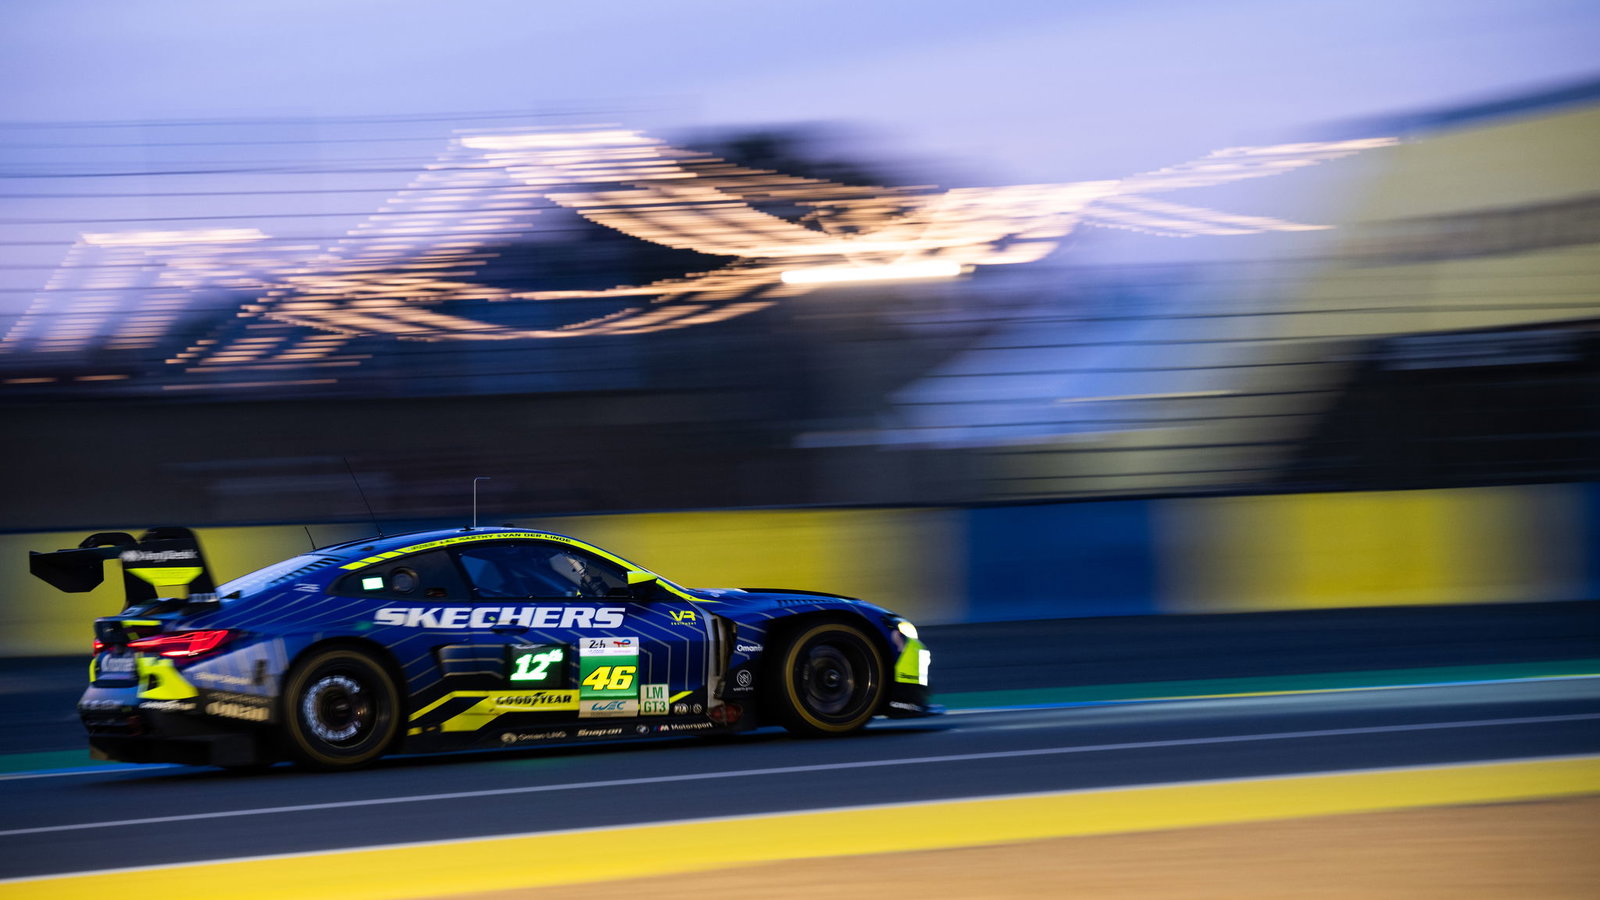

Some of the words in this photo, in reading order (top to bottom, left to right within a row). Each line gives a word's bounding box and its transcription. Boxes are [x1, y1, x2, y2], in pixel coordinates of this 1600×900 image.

[544, 534, 572, 543] LINDE
[373, 607, 626, 629] SKECHERS
[669, 610, 697, 621] VR
[582, 665, 637, 691] 46
[646, 686, 664, 699] LM
[496, 692, 572, 706] GOODYEAR
[643, 701, 666, 713] GT3
[671, 721, 713, 731] Motorsport
